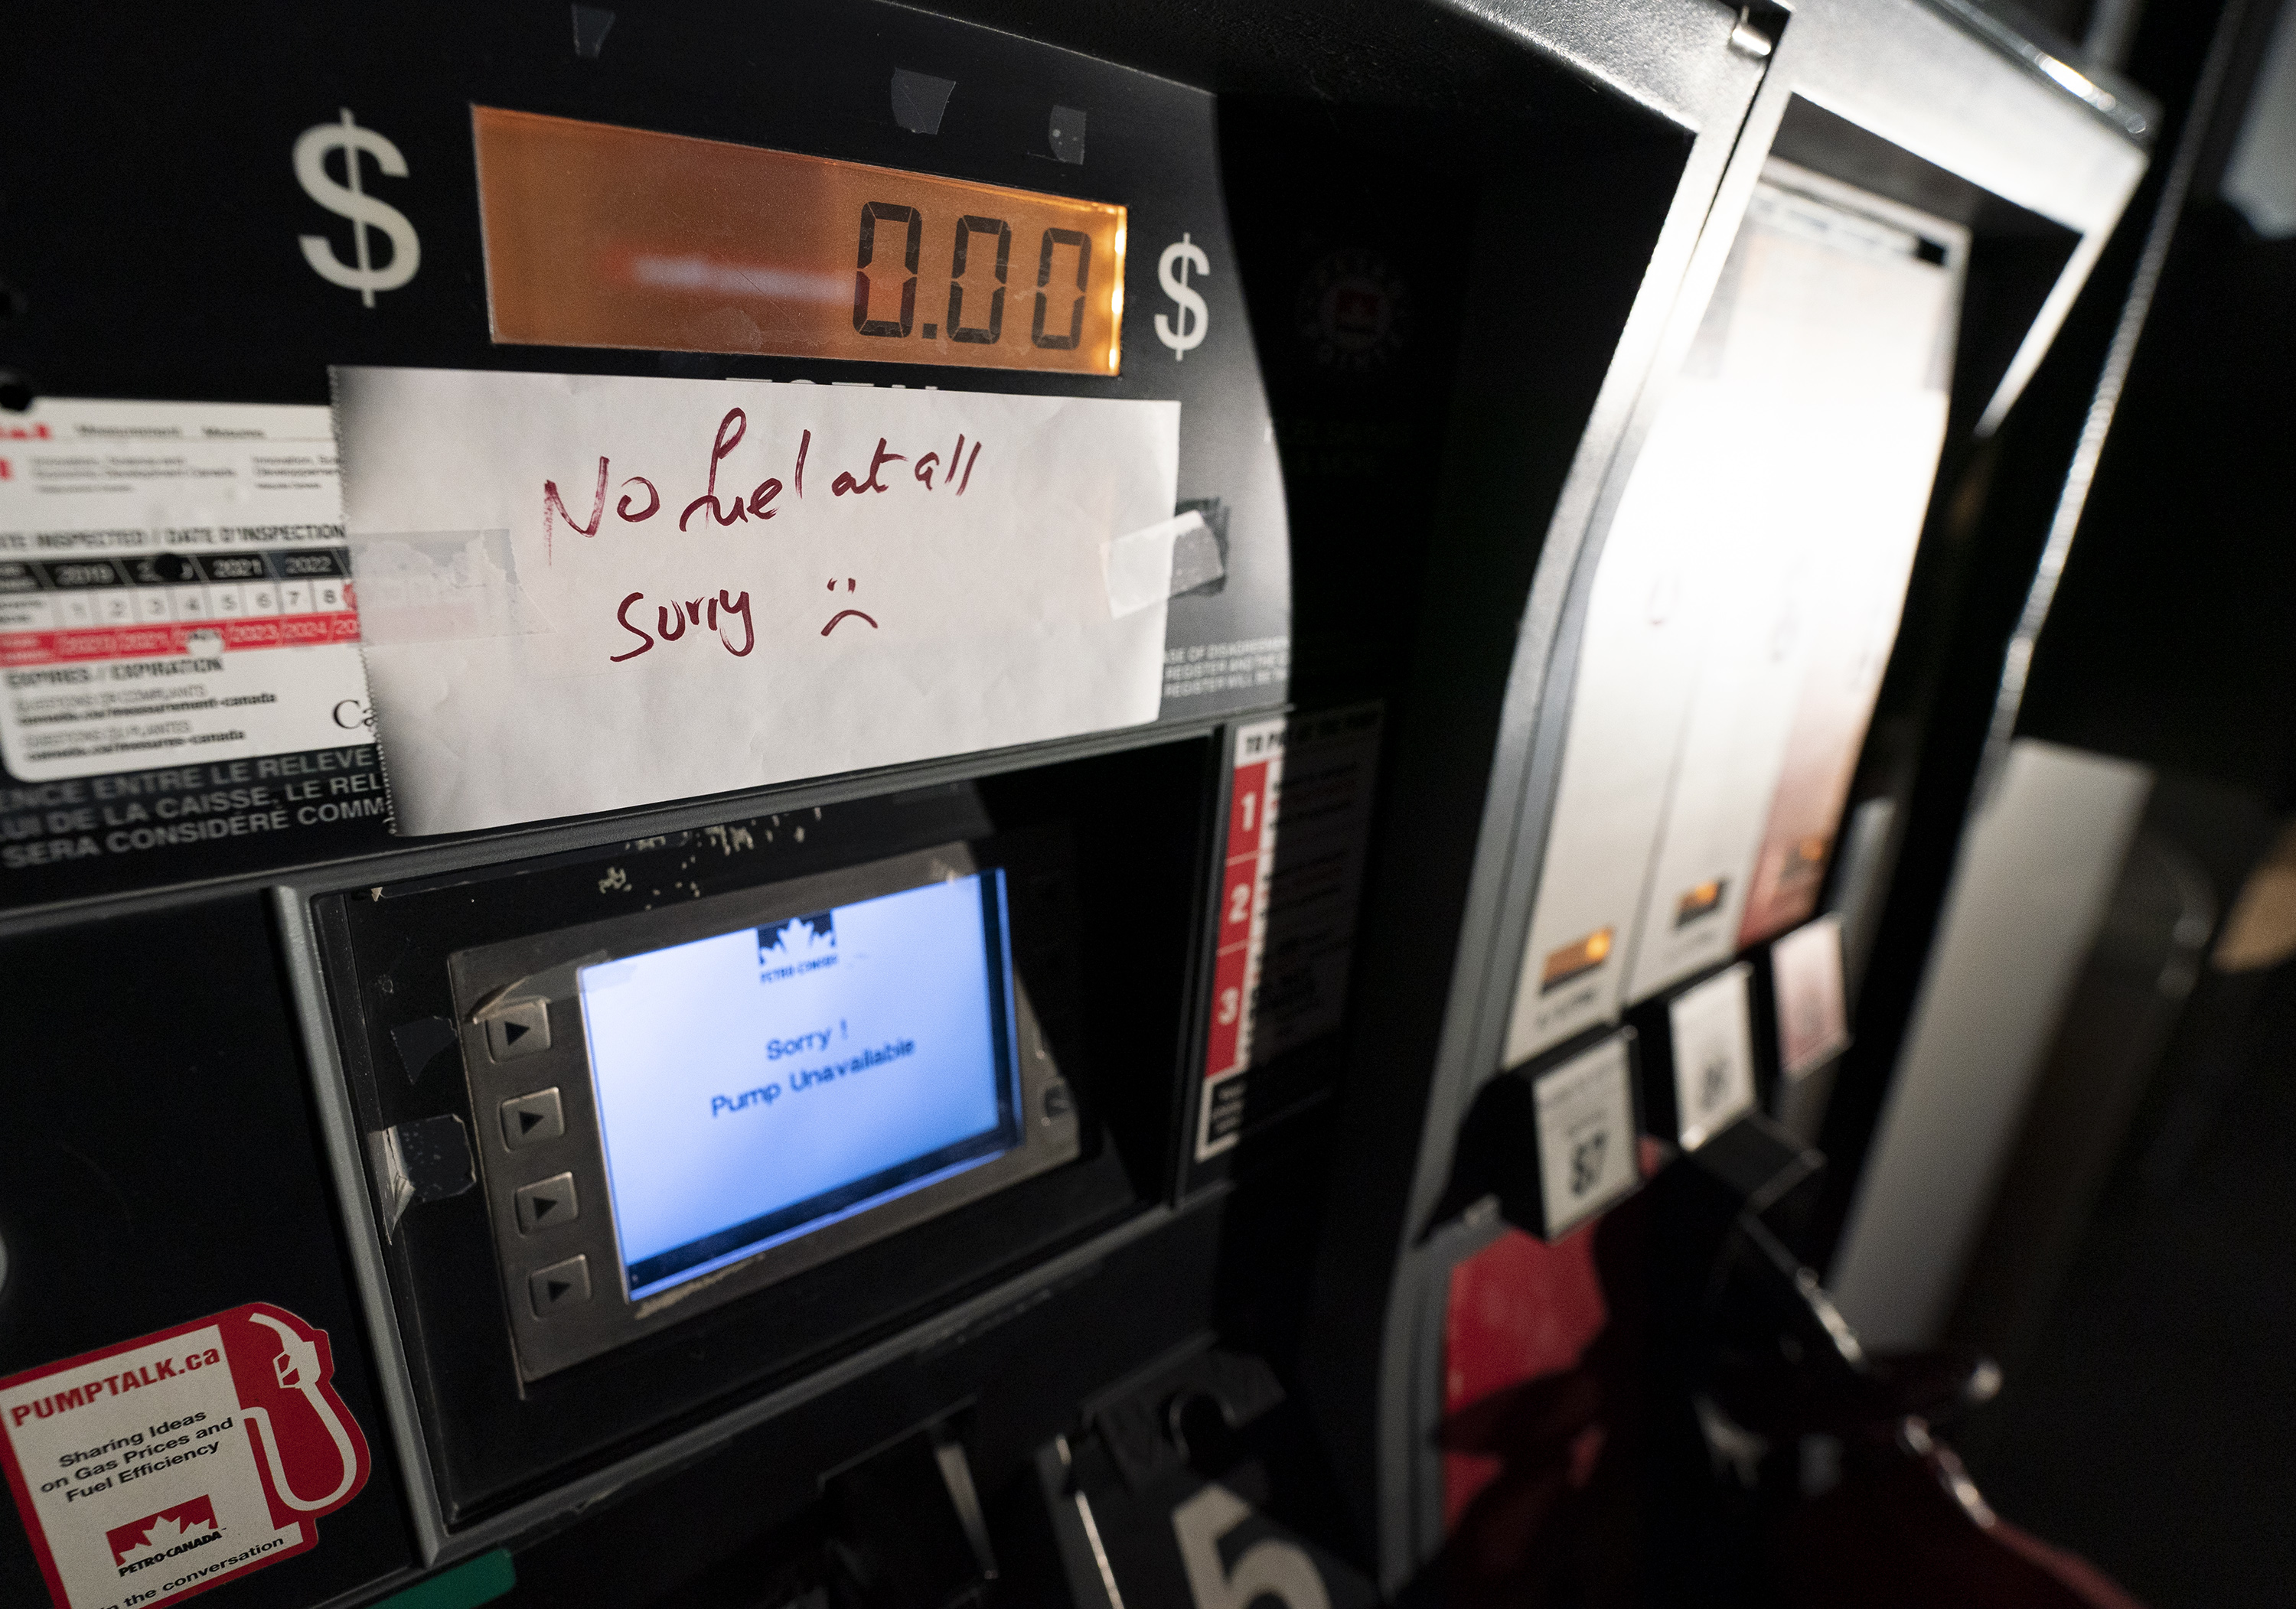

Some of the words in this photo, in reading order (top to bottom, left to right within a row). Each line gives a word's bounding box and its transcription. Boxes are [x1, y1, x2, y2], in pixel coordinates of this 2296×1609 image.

[293, 107, 422, 308] $
[851, 200, 1093, 351] 0.00
[1154, 232, 1210, 360] $
[543, 456, 660, 565] No
[679, 407, 811, 532] fuel
[831, 438, 908, 497] at
[915, 433, 982, 497] all
[165, 526, 214, 545] DATE
[212, 558, 263, 578] 2021
[285, 555, 332, 575] 2022
[287, 588, 302, 606] 7
[323, 588, 337, 605] 8
[46, 806, 98, 834] DE
[103, 802, 150, 826] LA
[285, 779, 322, 802] LE
[329, 773, 382, 796] REL
[92, 767, 202, 800] ENTRE
[210, 762, 251, 785] LE
[1241, 792, 1256, 832] 1
[2, 834, 101, 868] SERA
[297, 796, 383, 826] COMM
[1229, 884, 1251, 923] 2
[1218, 988, 1239, 1025] 3
[767, 1026, 832, 1062] Sorry
[711, 1082, 781, 1117] Pump
[790, 1037, 916, 1092] Unavailable
[10, 1347, 220, 1428] PUMPTALK.ca
[41, 1476, 69, 1494] on
[75, 1457, 118, 1480] Gas
[123, 1433, 191, 1464] Prices
[196, 1416, 233, 1440] and
[59, 1430, 144, 1470] Sharing
[149, 1409, 207, 1438] Ideas
[65, 1477, 113, 1503] Fuel
[119, 1440, 220, 1485] Efficiency
[124, 1589, 157, 1607] the
[162, 1537, 284, 1591] conversation
